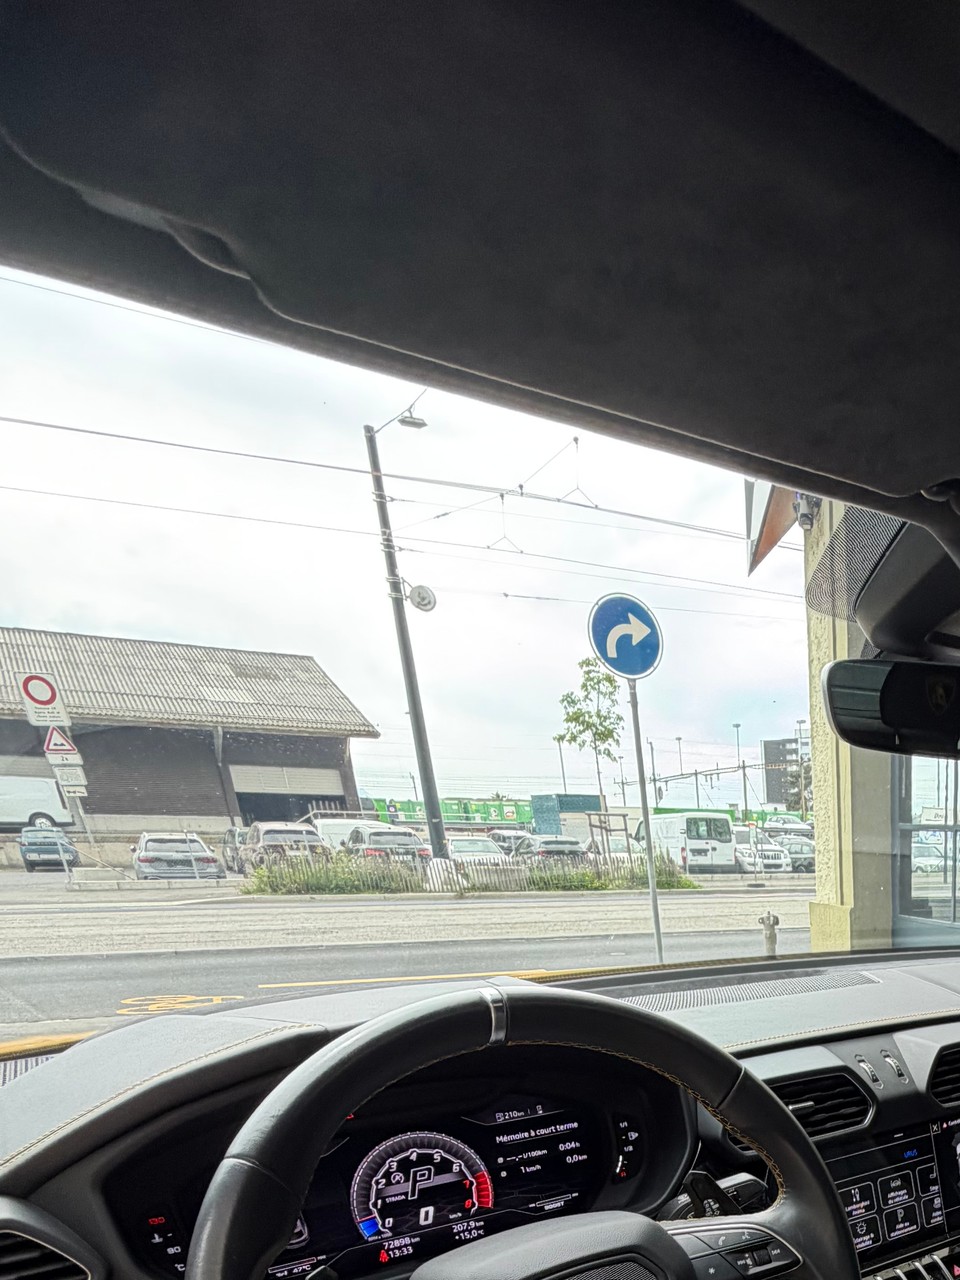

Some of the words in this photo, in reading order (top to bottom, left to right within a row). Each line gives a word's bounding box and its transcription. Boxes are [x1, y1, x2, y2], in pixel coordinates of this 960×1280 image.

[496, 1130, 529, 1143] Mémoire
[536, 1125, 556, 1135] court
[556, 1122, 578, 1132] terme
[409, 1152, 417, 1161] 4
[433, 1153, 441, 1162] 5
[389, 1162, 397, 1172] 3
[452, 1163, 460, 1172] 6
[378, 1179, 386, 1188] 2
[408, 1166, 434, 1200] P
[463, 1180, 470, 1188] 7
[465, 1199, 472, 1209] 8
[419, 1206, 434, 1226] 0
[385, 1218, 393, 1227] 0
[452, 1221, 475, 1233] 207,9
[383, 1237, 411, 1250] 72898
[389, 1246, 413, 1258] 13:33
